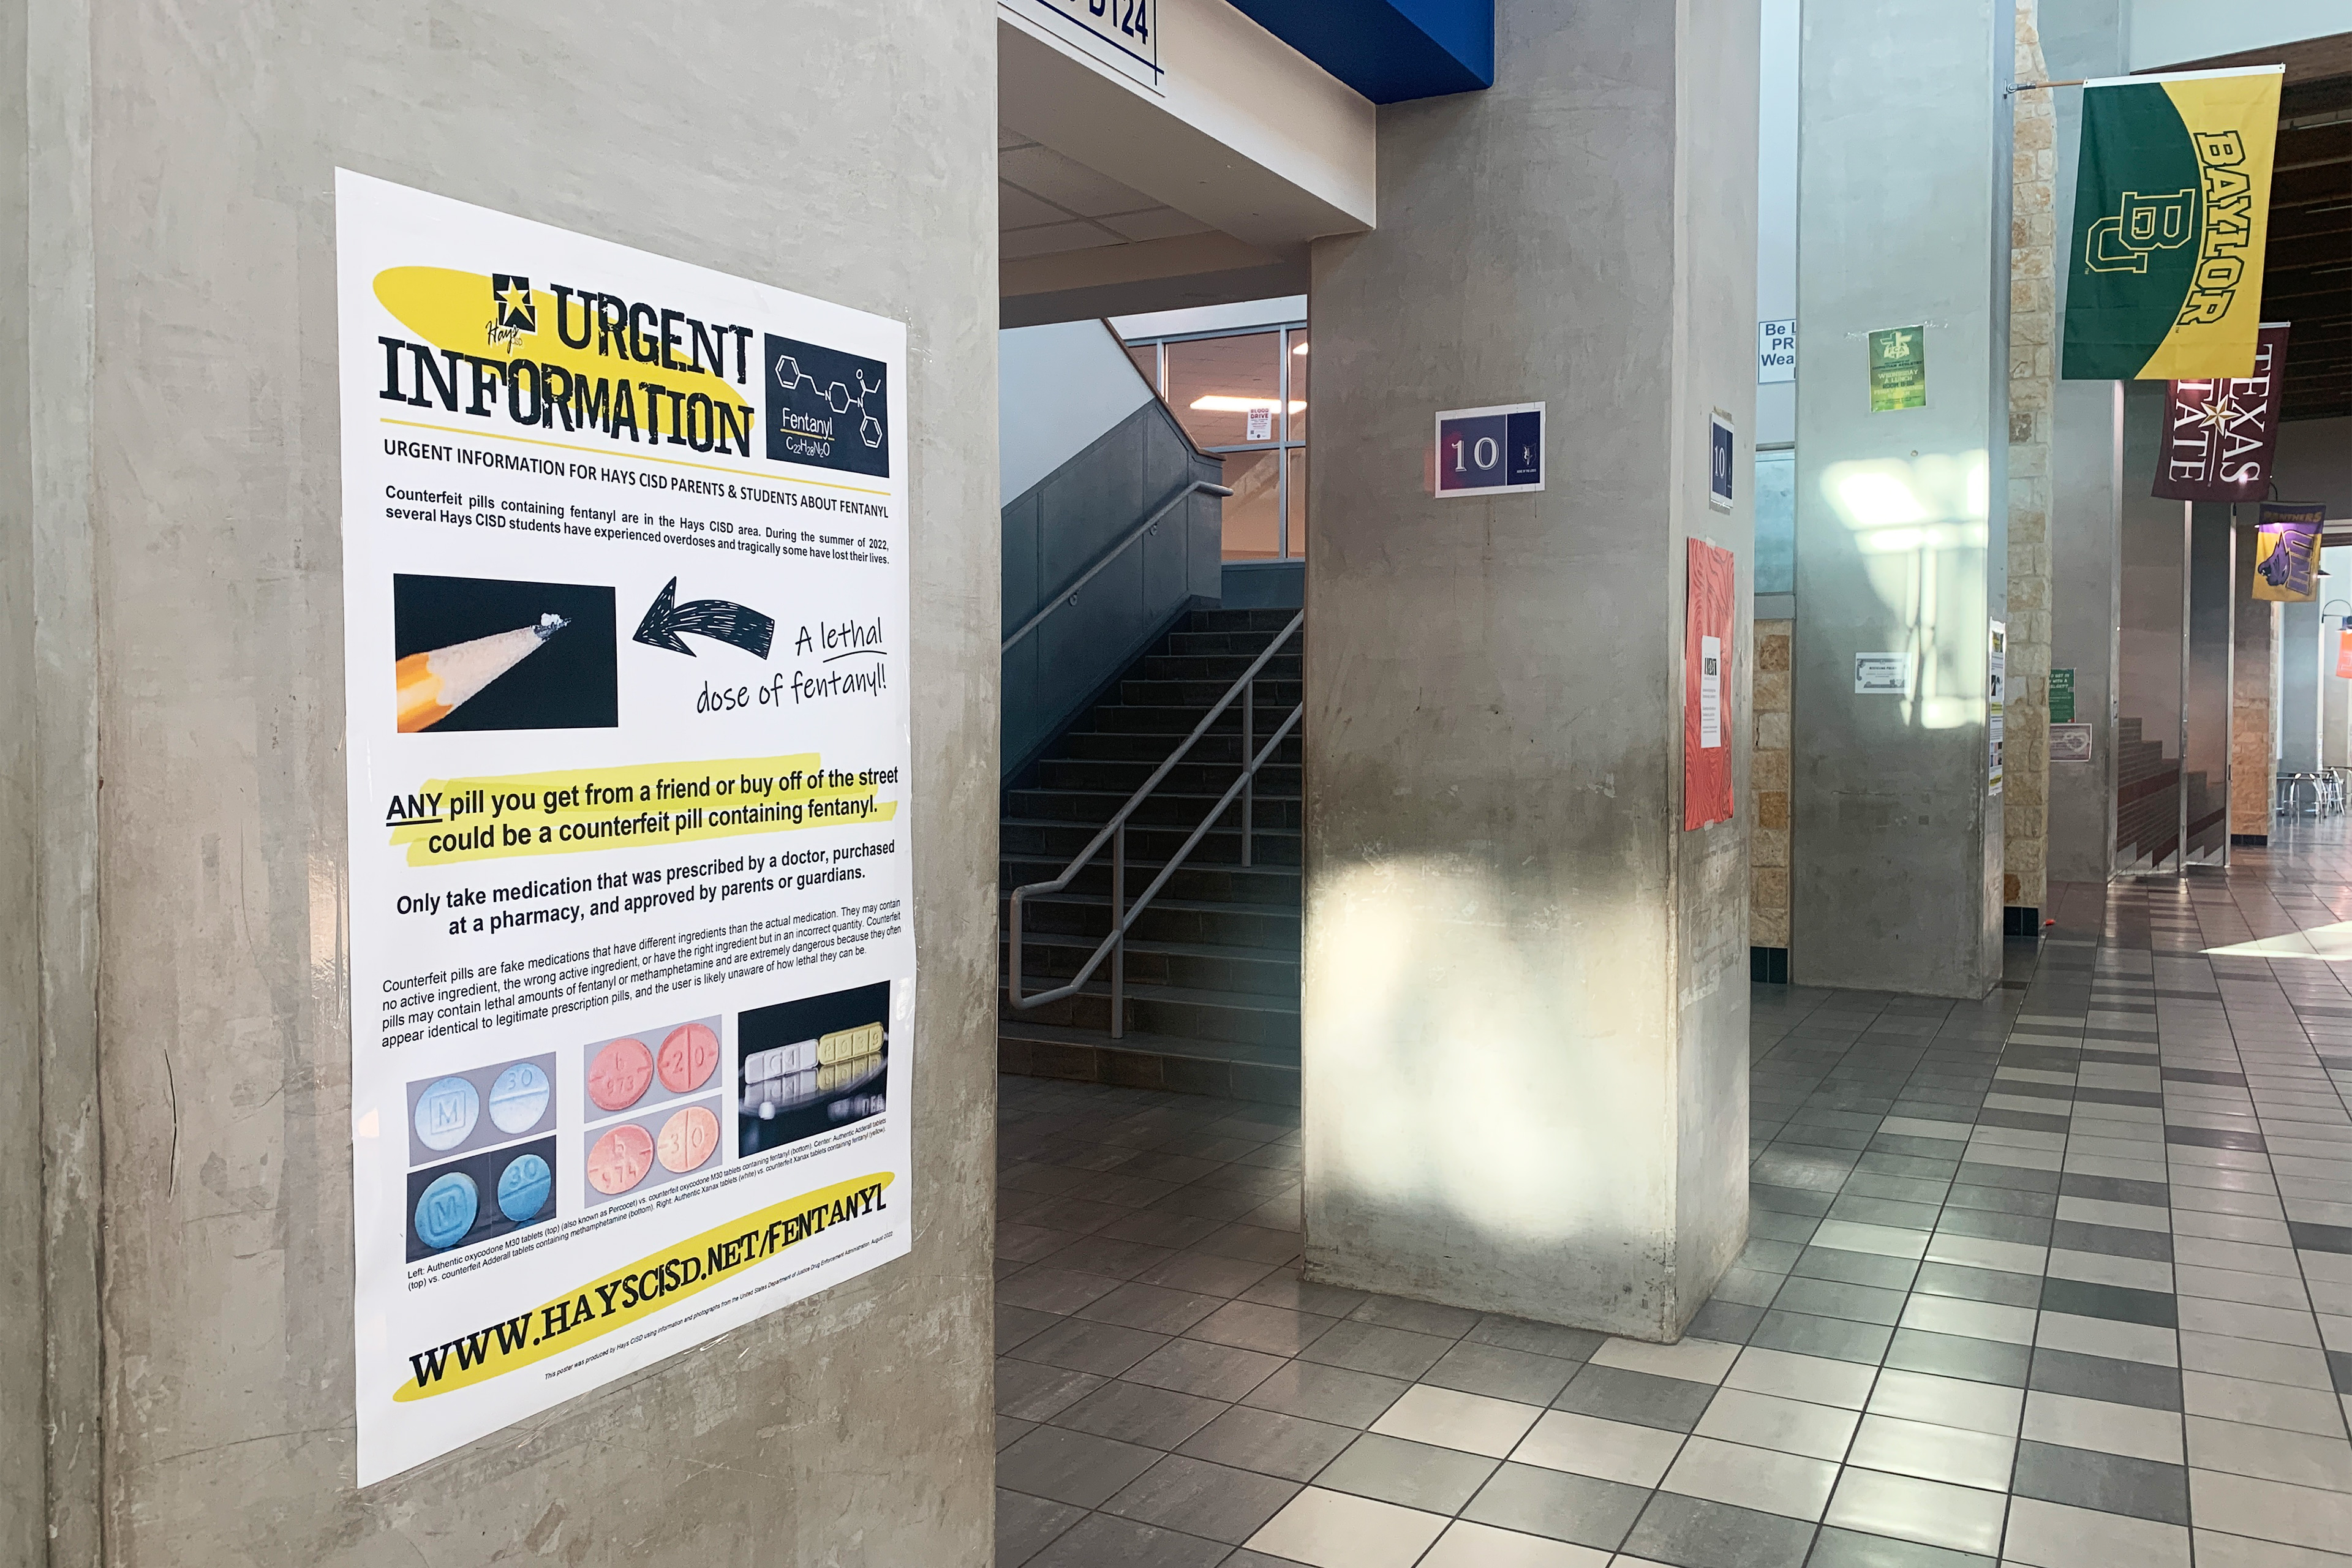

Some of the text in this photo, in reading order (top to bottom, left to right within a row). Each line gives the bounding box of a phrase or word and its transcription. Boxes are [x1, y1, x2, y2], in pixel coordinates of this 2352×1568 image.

[2085, 188, 2196, 274] BU
[2176, 130, 2252, 325] BAYLOR
[485, 317, 519, 354] Hays
[550, 282, 753, 385] URGENT
[1765, 323, 1785, 336] Be
[1772, 337, 1795, 350] PR
[1761, 353, 1795, 366] Wea
[1878, 369, 1918, 379] WEDNESDAY
[379, 336, 755, 458] INFORMATION
[782, 407, 832, 440] Fentanyl
[2219, 344, 2274, 483] TEXAS
[1452, 437, 1499, 472] 10
[2169, 378, 2215, 482] TATE
[384, 439, 889, 518] URGENT INFORMATION FOR HAYS CISD PARENTS & STUDENTS ABOUT FENTANYL
[1714, 445, 1725, 479] 10
[385, 485, 889, 552] Counterfeit pills containing fentanyl are in the Hays CISD area. During the summer of 2022,
[386, 507, 889, 565] several Hays CISD students have experienced overdoses and tragically some have lost their lives.
[795, 617, 882, 656] A lethal
[696, 662, 887, 714] dose of fentanyl!
[386, 766, 899, 821] ANY pill you get from a friend or buy off of the street
[429, 794, 877, 854] could be a counterfeit pill containing fentanyl.
[396, 839, 895, 916] Only take medication that was prescribed by a doctor, purchased
[382, 899, 900, 993] Counterfeit pills are fake medications that have different ingredients than the actual medication. They may contain
[507, 1068, 533, 1090] 30
[606, 1076, 634, 1096] 973
[438, 1099, 458, 1128] M
[508, 1158, 539, 1188] 30
[434, 1196, 458, 1227] M
[407, 1267, 425, 1280] Left:
[426, 1256, 464, 1274] Authentic
[464, 1244, 503, 1262] oxycodone
[505, 1237, 521, 1250] M30
[521, 1231, 543, 1243] tablets
[545, 1224, 560, 1237] (top)
[561, 1220, 577, 1232] (also
[578, 1213, 599, 1225] known
[608, 1199, 638, 1215] Percocet)
[409, 1183, 887, 1387] WWW.HAYSCISD.NET/FENTANYL
